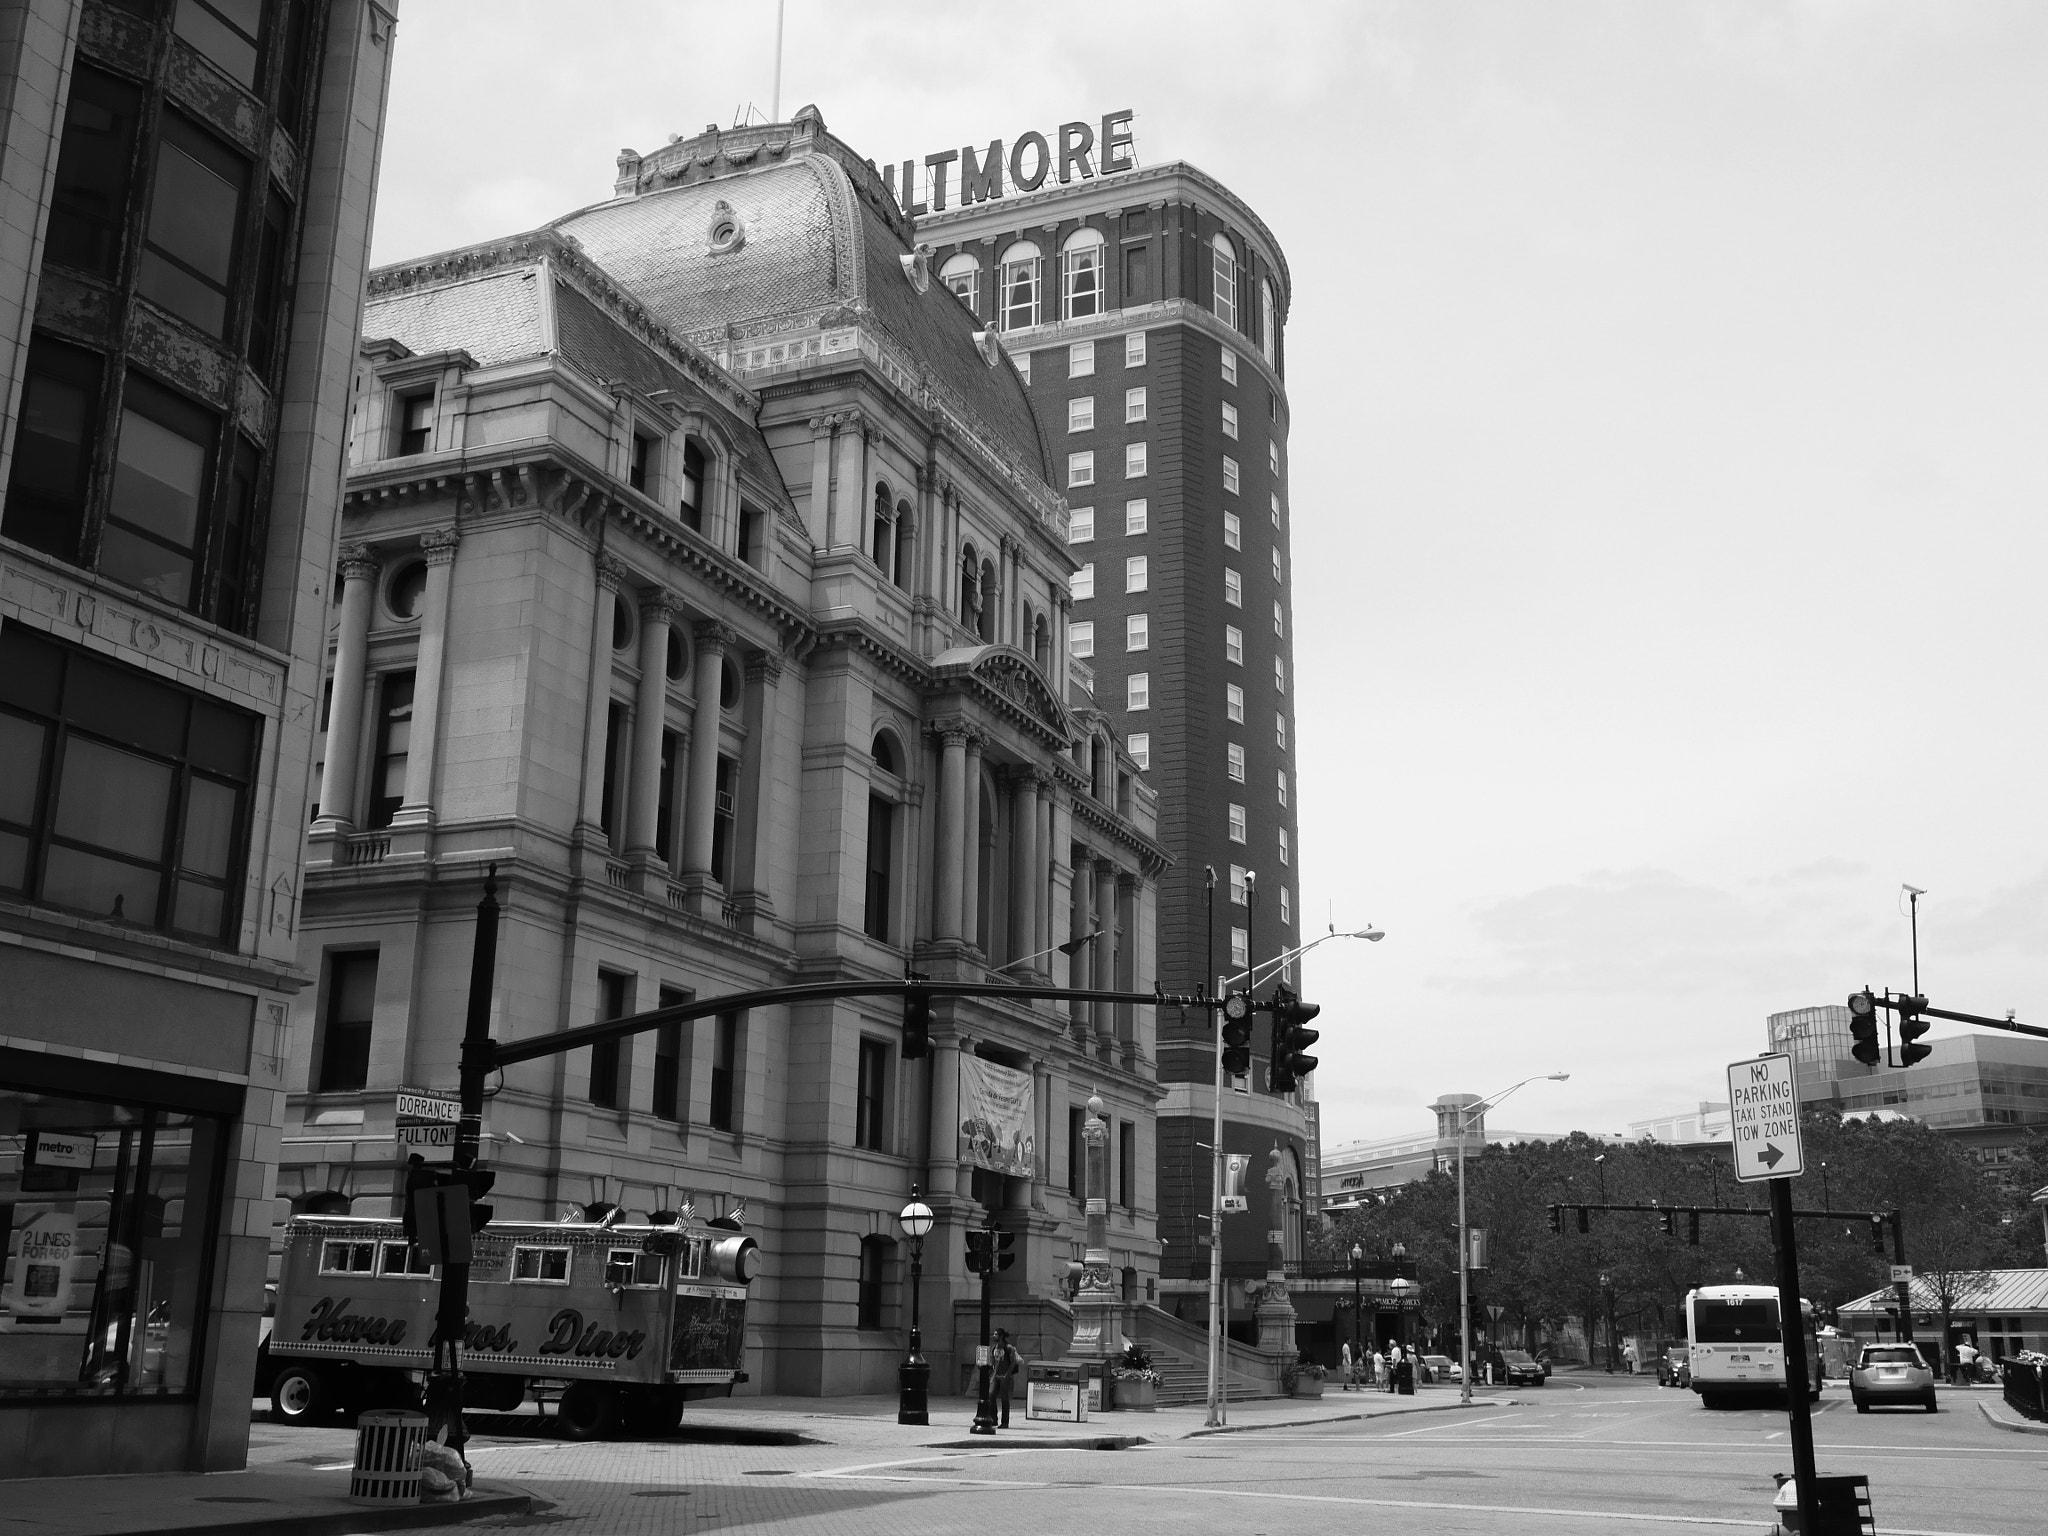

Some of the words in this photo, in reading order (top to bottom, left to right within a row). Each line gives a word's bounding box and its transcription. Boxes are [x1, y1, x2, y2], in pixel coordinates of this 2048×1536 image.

[1750, 1063, 1769, 1084] NO
[427, 1088, 440, 1097] Arts
[1735, 1080, 1790, 1106] PARKING
[399, 1096, 453, 1119] DORRANCE
[453, 1104, 460, 1113] ST
[1735, 1107, 1756, 1123] TAXI
[1760, 1102, 1793, 1119] STAND
[397, 1127, 449, 1143] FULTON
[449, 1127, 456, 1136] ST
[1736, 1124, 1759, 1142] TOW
[1765, 1119, 1795, 1138] ZONE
[38, 1141, 93, 1157] metroPCS
[23, 1230, 32, 1246] 2
[34, 1231, 71, 1247] LINES
[21, 1245, 48, 1260] FOR
[1892, 1269, 1902, 1278] P
[301, 1297, 407, 1346] Haven
[428, 1306, 518, 1353] ros.
[539, 1308, 646, 1360] Diner
